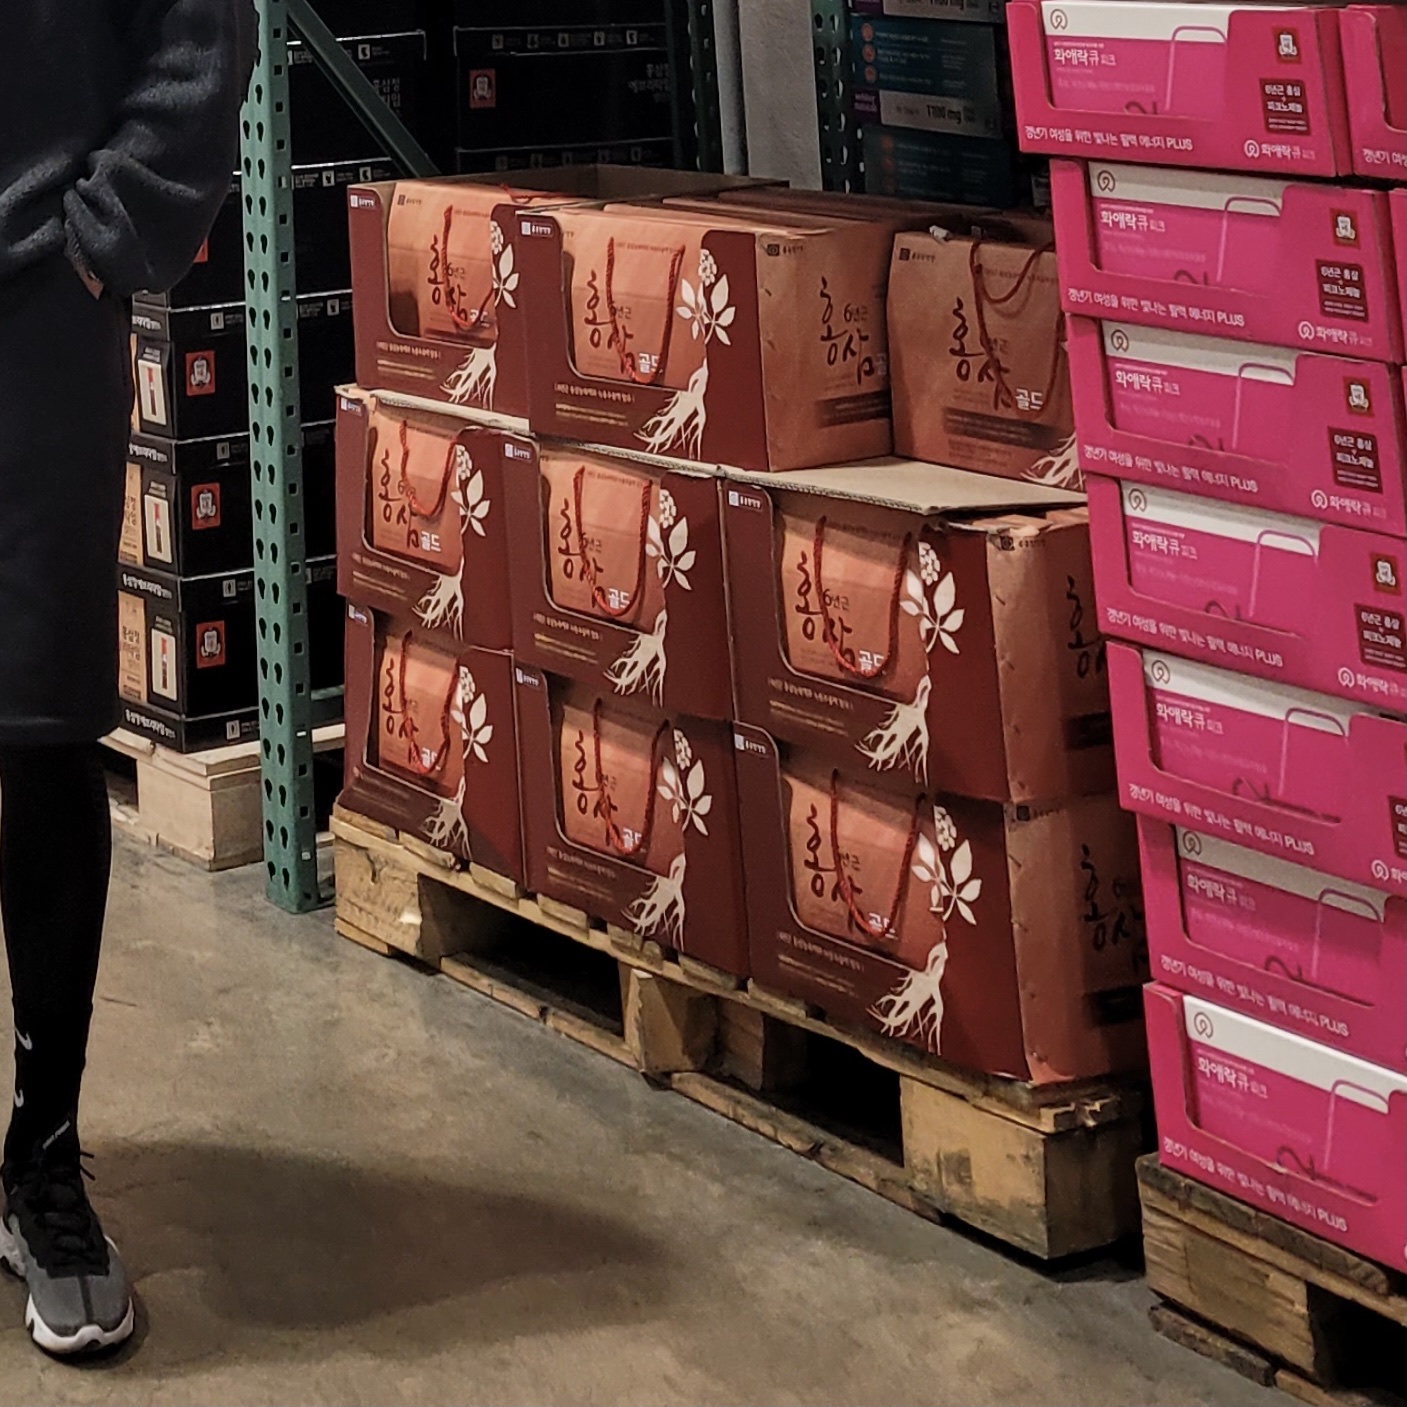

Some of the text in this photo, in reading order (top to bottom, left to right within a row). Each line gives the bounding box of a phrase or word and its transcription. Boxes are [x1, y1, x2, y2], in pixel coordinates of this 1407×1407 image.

[1166, 137, 1194, 151] PLUS
[1217, 311, 1245, 328] PLUS
[1015, 387, 1044, 412] 골드
[1230, 476, 1259, 493] PLUS
[1255, 648, 1283, 668] PLUS
[1284, 830, 1315, 855] PLUS
